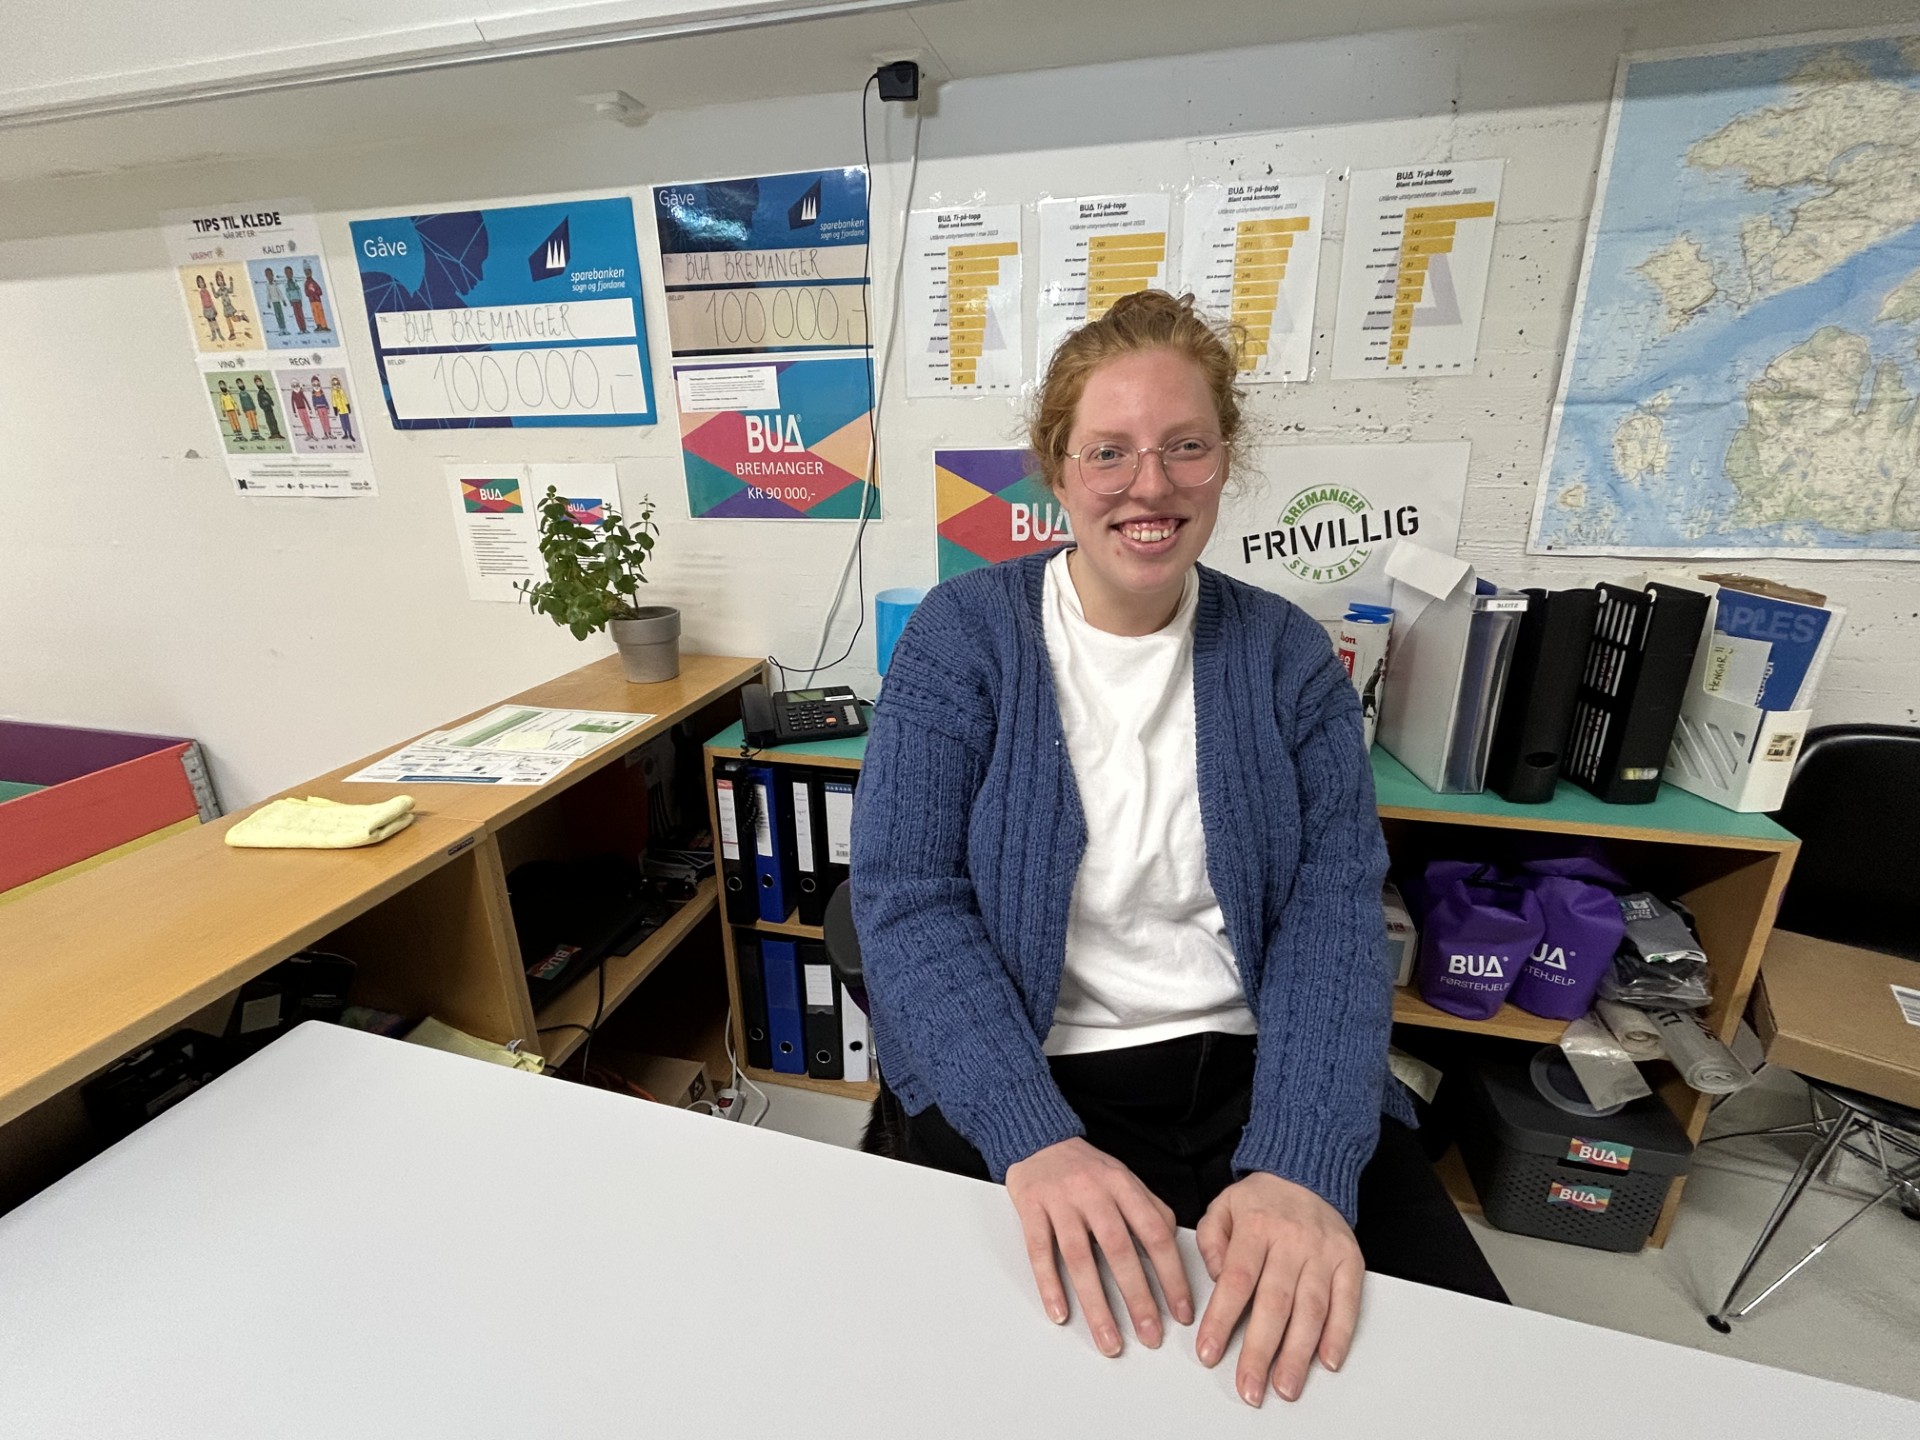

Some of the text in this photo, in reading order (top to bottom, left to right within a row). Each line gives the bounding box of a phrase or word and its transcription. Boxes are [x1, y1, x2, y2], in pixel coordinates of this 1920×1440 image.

[659, 188, 694, 207] Gåve
[193, 211, 282, 232] TIPS TIL KLEDE
[820, 218, 864, 232] sparebanken
[262, 244, 286, 255] KALDT
[363, 236, 408, 258] Gåve
[685, 249, 824, 281] BUA BREMANGER
[570, 267, 625, 284] sparebanken
[572, 280, 626, 293] sogn og fjordane
[402, 303, 577, 344] BUA BREMANGER
[706, 291, 767, 345] 100
[218, 360, 236, 369] VIND
[289, 357, 310, 366] REGN
[433, 354, 510, 414] 100
[745, 414, 805, 454] BUA
[736, 461, 824, 475] BREMANGER
[479, 488, 503, 501] BUA
[747, 487, 816, 502] KR 90 000,-
[1282, 488, 1366, 526] BREMANGER
[1011, 502, 1076, 542] BUA
[1242, 505, 1419, 564] FRIVILLIG
[1289, 547, 1368, 580] SENTRAL
[1448, 954, 1504, 978] BUA
[1440, 975, 1510, 992] FØRSTEHJELP
[1578, 1145, 1618, 1164] BUA
[1559, 1188, 1597, 1205] BUA
